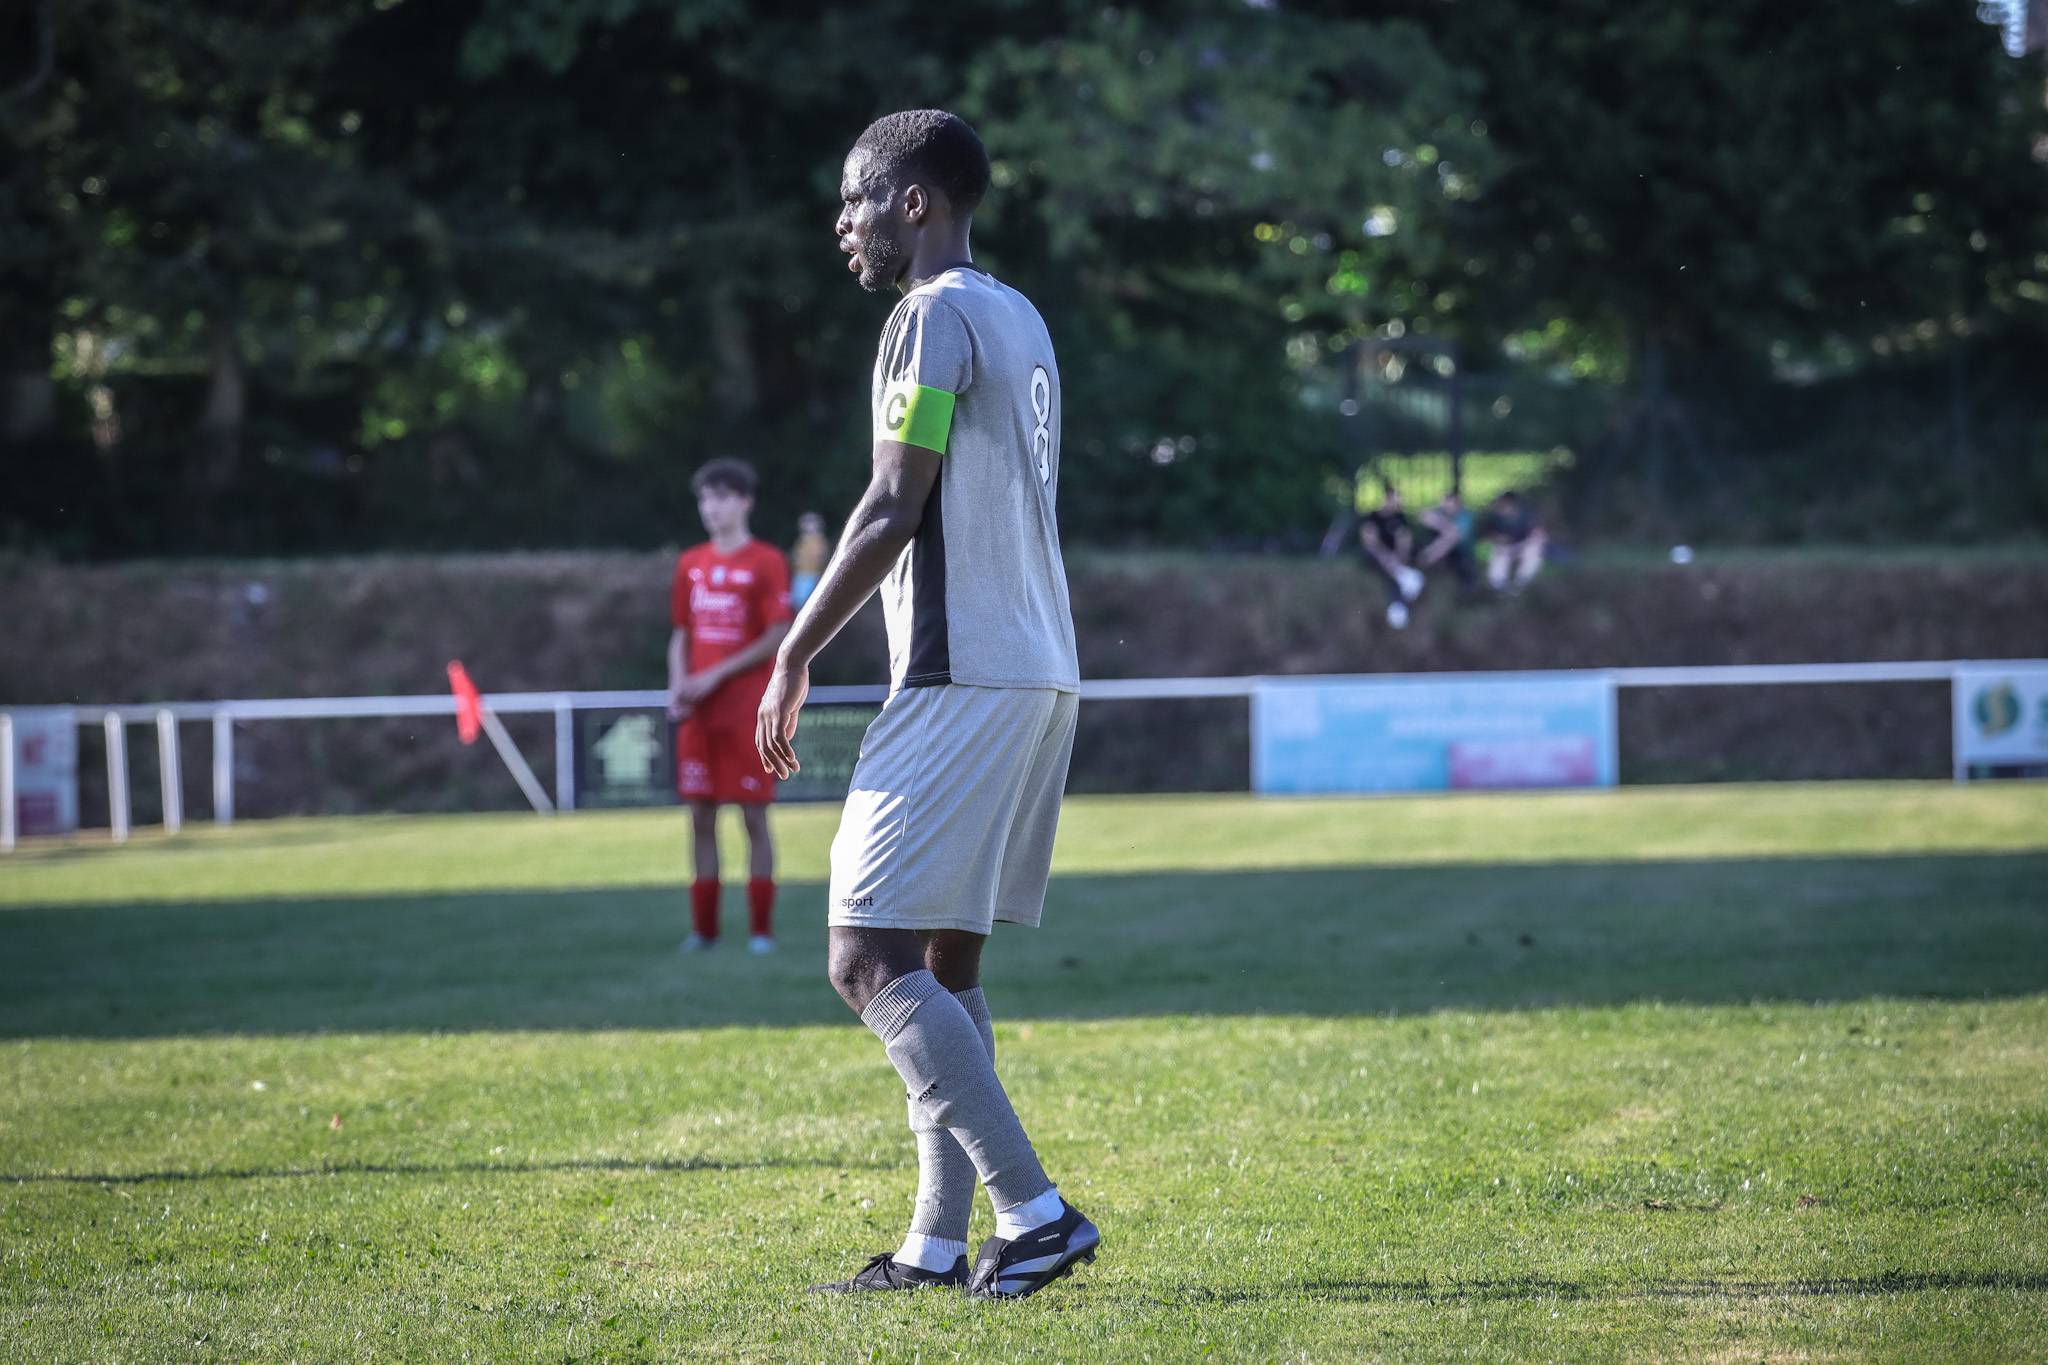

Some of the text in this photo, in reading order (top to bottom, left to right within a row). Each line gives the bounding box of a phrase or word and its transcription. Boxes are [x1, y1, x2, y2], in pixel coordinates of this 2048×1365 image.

[886, 393, 907, 431] C
[1030, 365, 1051, 485] 8
[841, 896, 874, 909] sport
